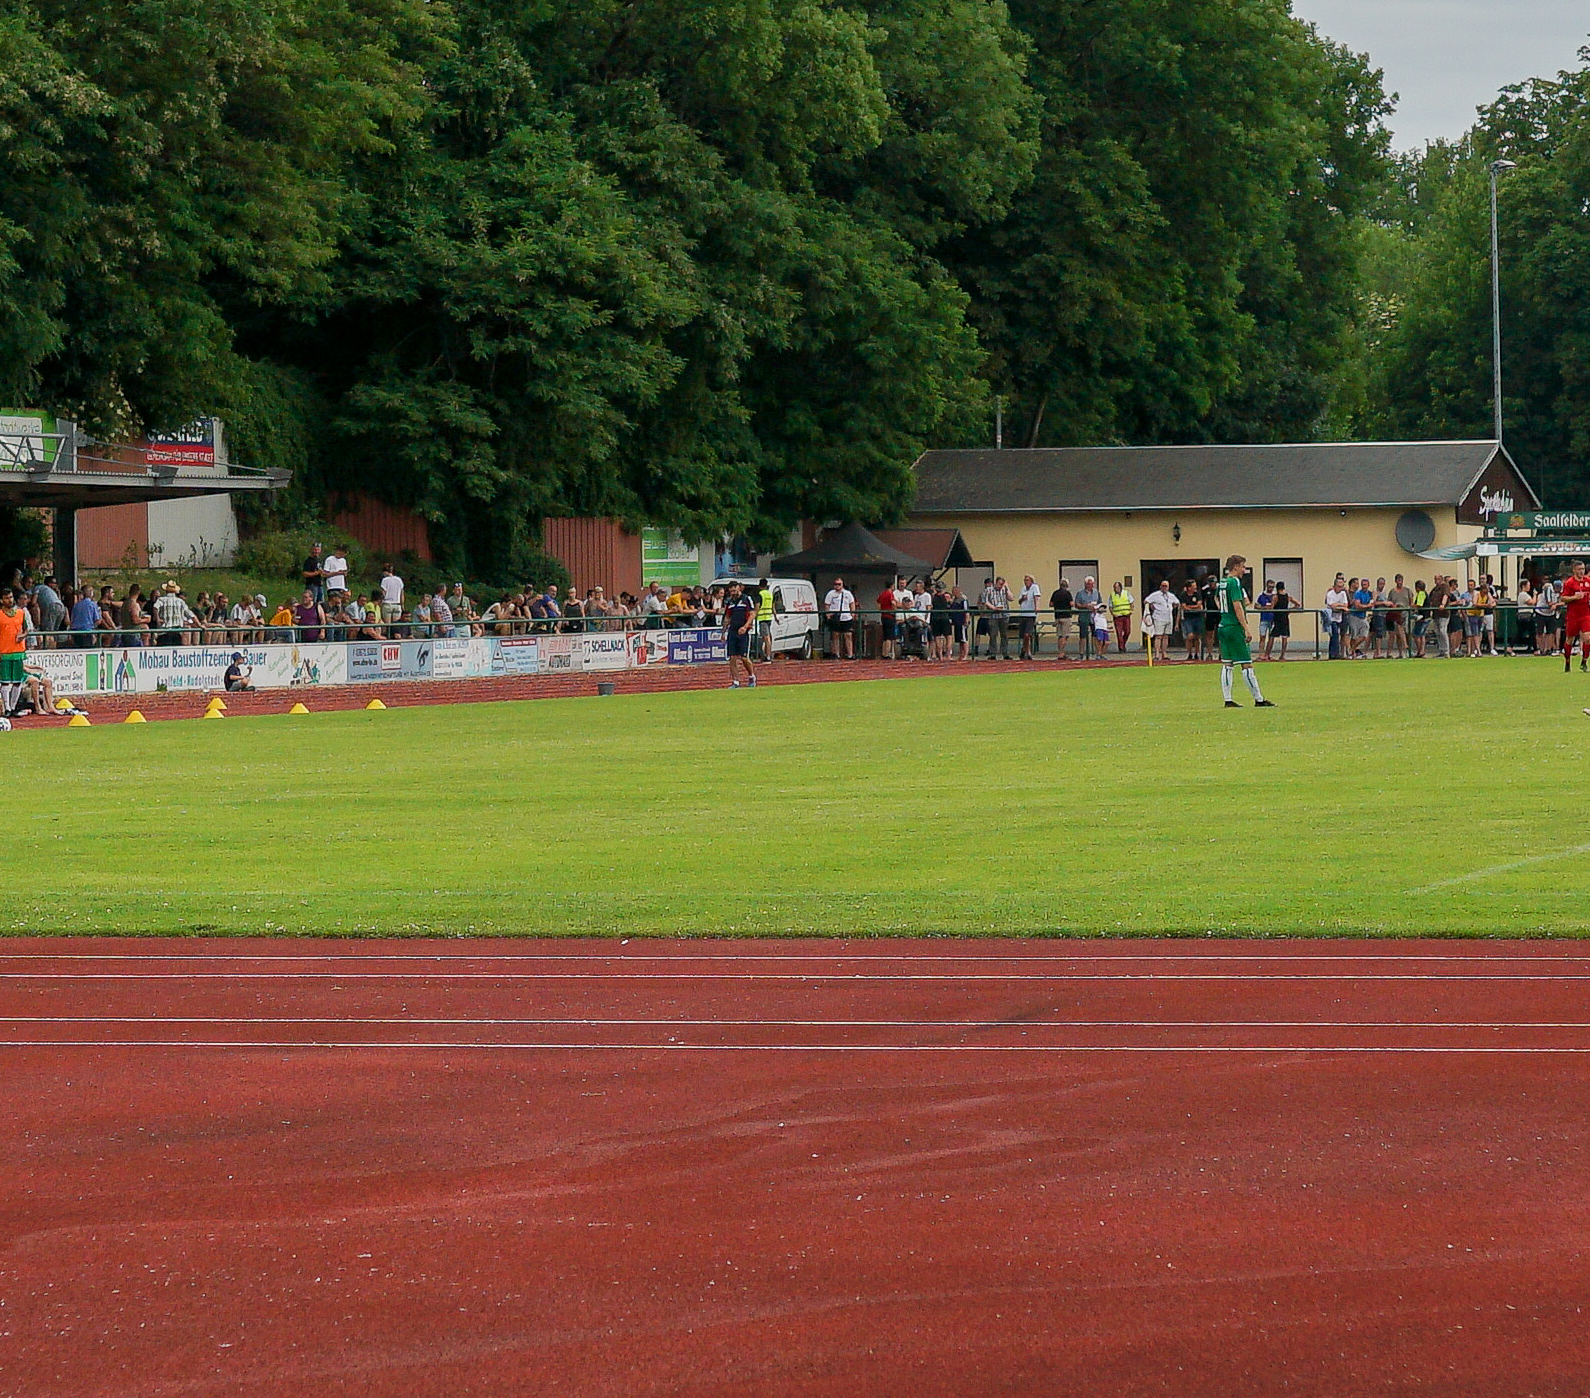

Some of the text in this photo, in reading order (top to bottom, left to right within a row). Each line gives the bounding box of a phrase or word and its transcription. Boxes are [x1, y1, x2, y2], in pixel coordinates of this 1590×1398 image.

[1534, 513, 1590, 528] Saalfelder
[139, 651, 169, 669] Mobau
[173, 649, 237, 668] Baustoffzentr
